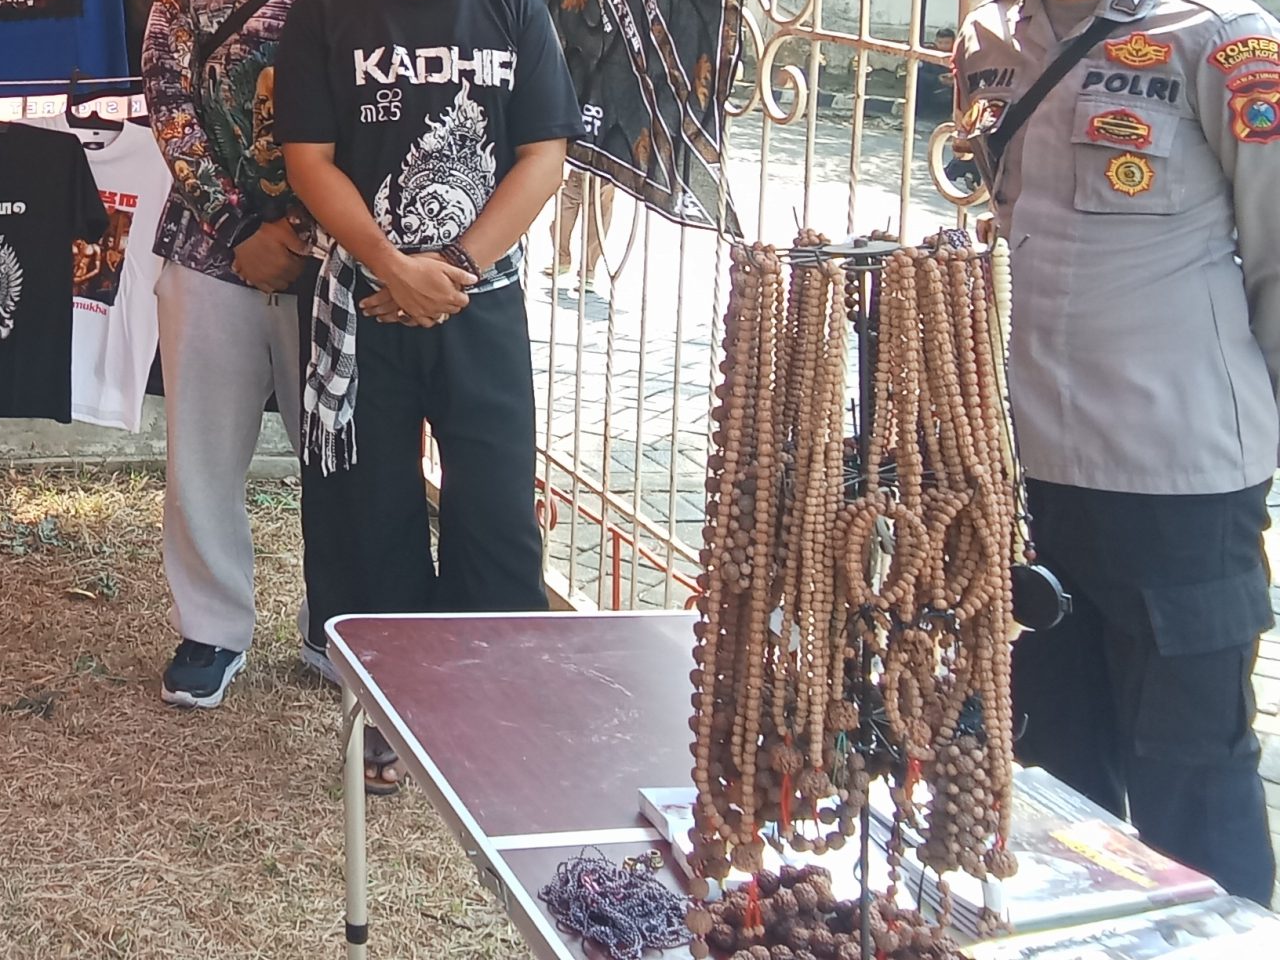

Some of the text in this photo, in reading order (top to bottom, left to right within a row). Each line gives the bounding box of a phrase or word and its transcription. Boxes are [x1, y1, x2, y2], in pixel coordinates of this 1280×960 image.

[1215, 38, 1279, 65] POLRES
[1255, 49, 1279, 61] KOTA
[1081, 71, 1180, 103] POLRI
